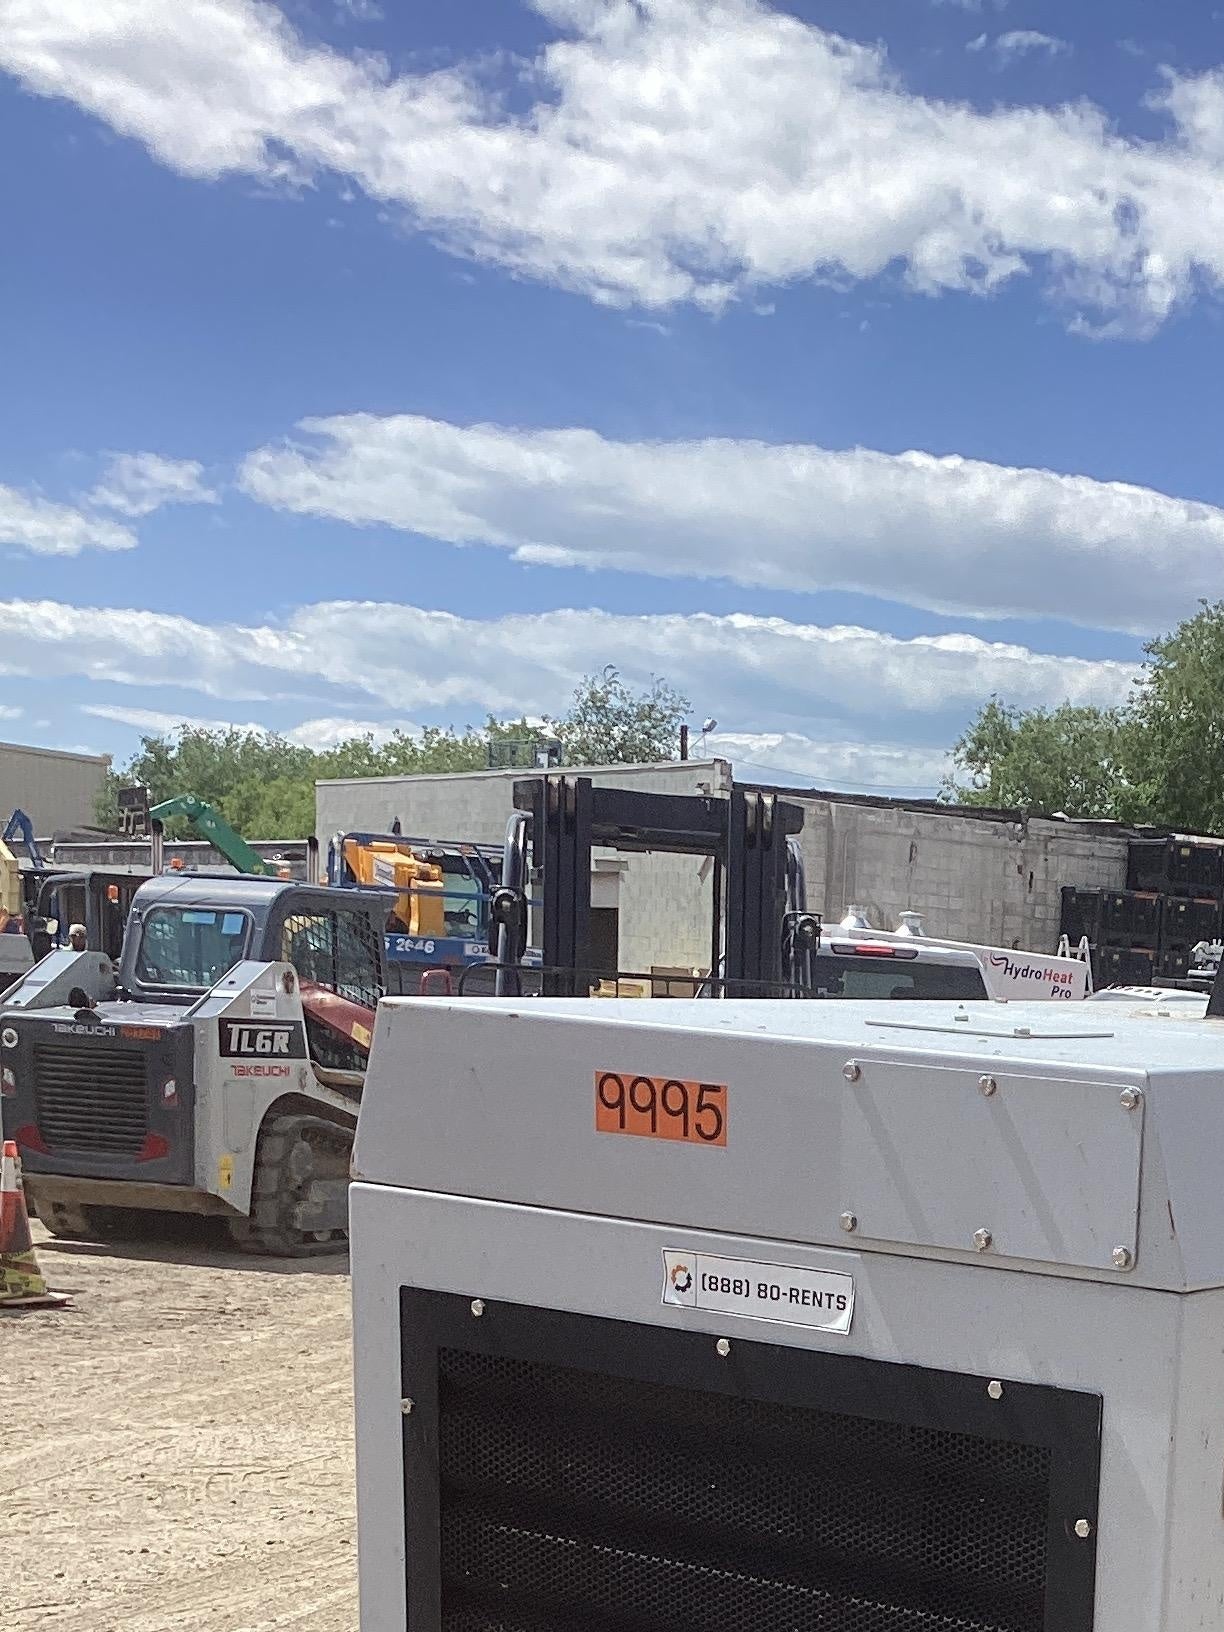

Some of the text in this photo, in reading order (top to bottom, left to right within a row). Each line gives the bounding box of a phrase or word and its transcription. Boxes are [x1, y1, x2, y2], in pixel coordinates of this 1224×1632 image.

[396, 938, 435, 954] 2646
[1003, 962, 1073, 985] HydroHeat
[1051, 985, 1072, 999] Pro
[52, 1023, 116, 1037] TAKEUCHI
[227, 1023, 295, 1053] TL6R
[231, 1064, 291, 1077] TAKEUCHI
[599, 1072, 723, 1141] 9995
[701, 1272, 847, 1312] (888) 80-RENTS
